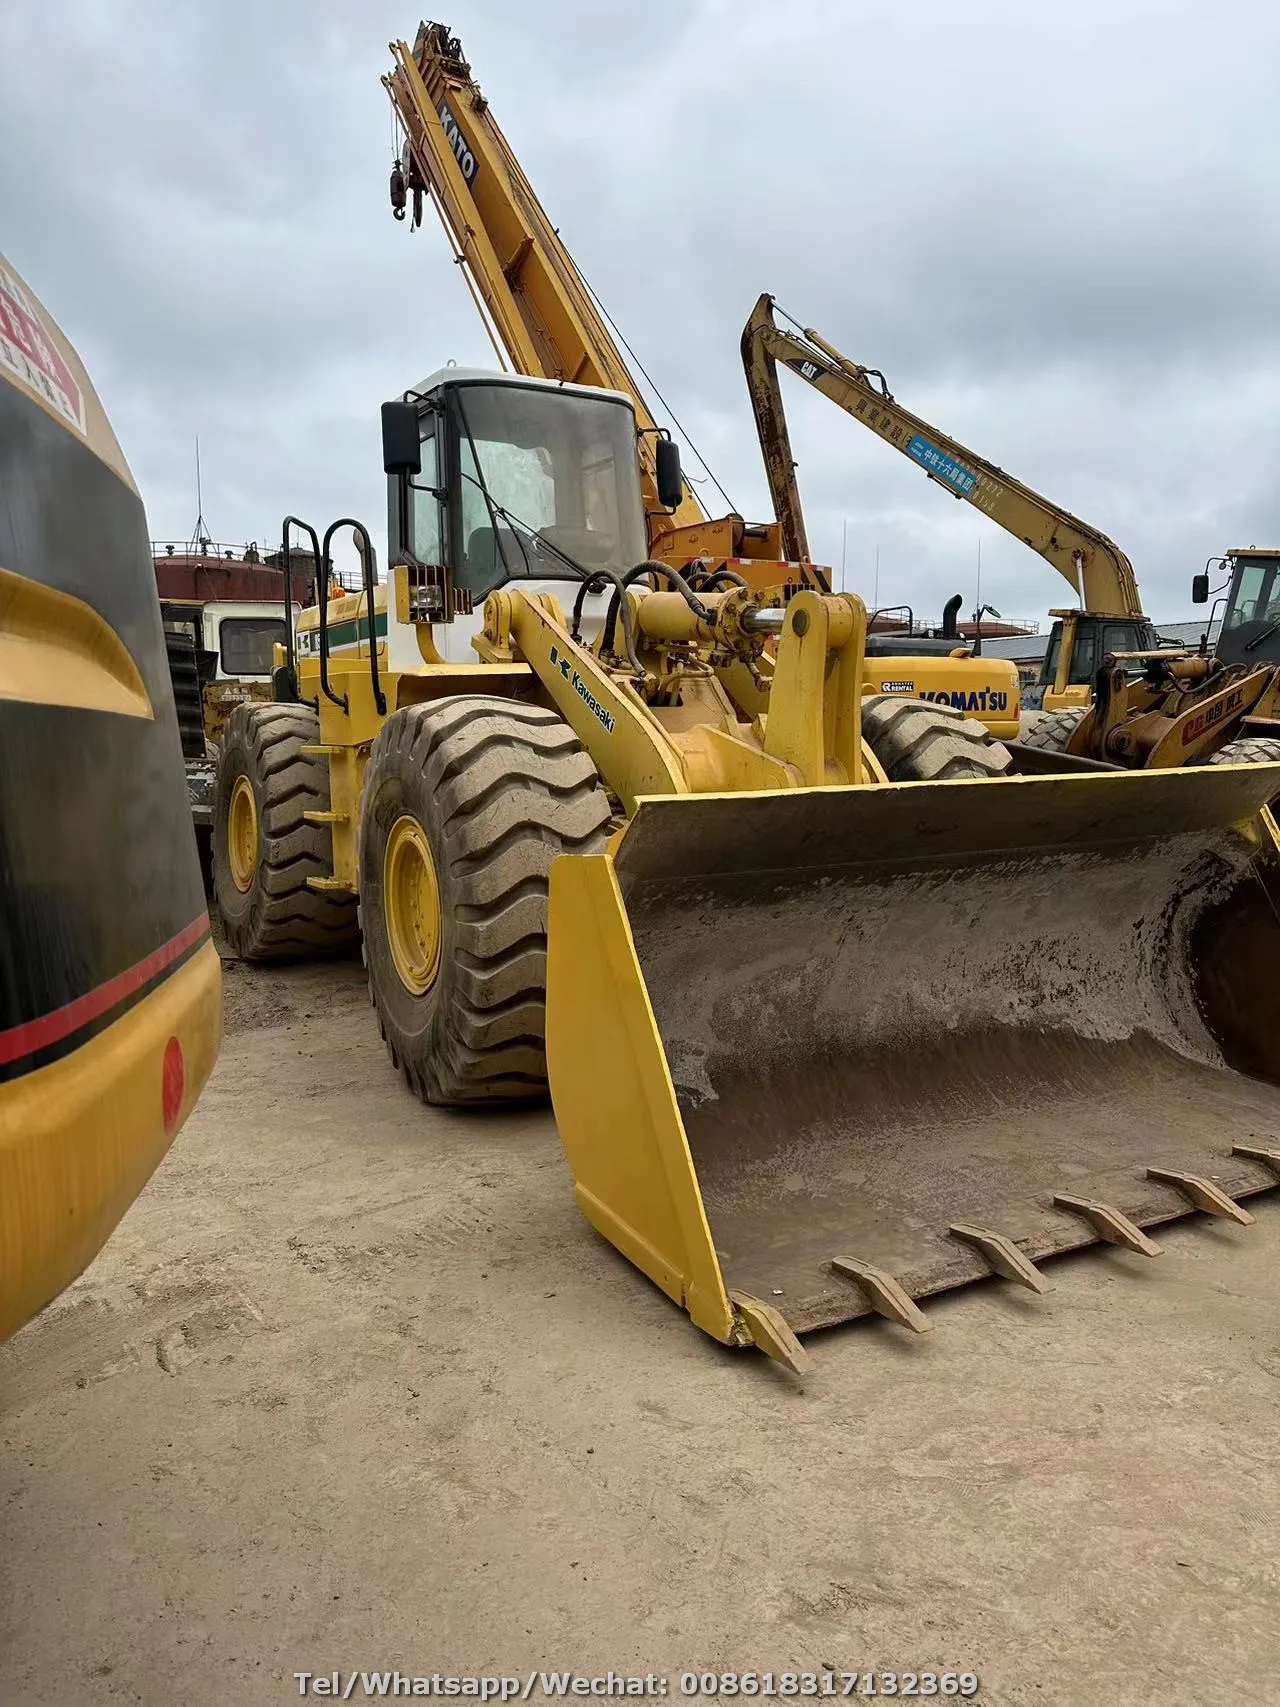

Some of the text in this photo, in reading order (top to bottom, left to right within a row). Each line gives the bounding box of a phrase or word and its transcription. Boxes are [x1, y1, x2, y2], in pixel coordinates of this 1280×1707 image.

[440, 106, 474, 179] KATO
[801, 361, 818, 379] CAT
[924, 449, 974, 491] 中铁十六局集团
[571, 670, 616, 734] Kawasaki
